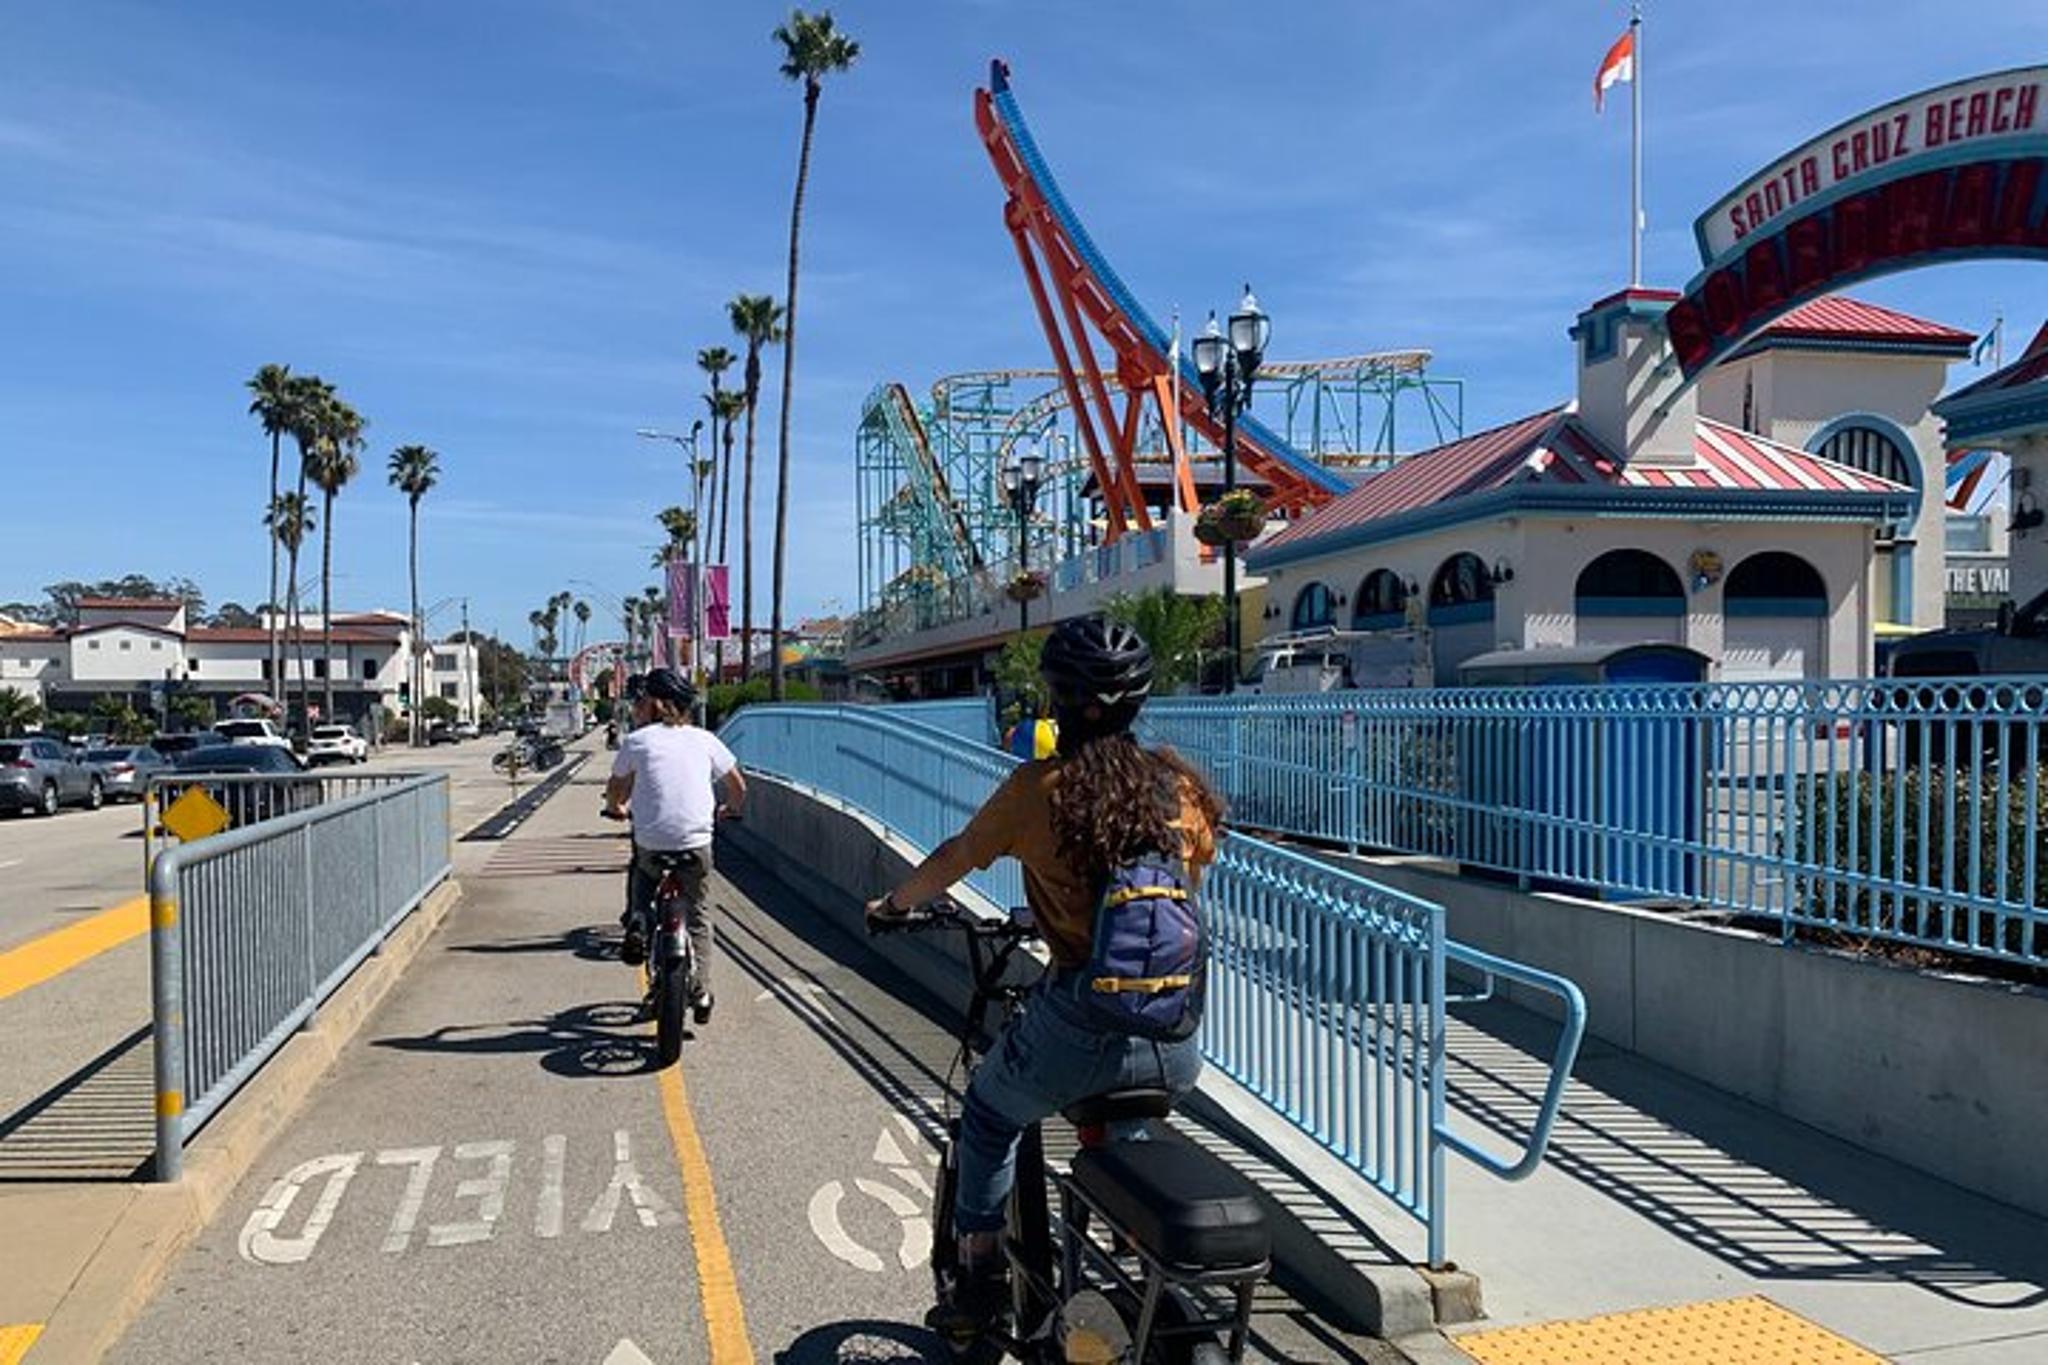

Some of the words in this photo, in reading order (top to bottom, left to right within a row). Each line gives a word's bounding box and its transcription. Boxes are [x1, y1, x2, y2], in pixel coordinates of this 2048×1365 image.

[1729, 157, 1819, 239] SANTA
[1831, 114, 1910, 181] CRUZ
[1925, 84, 2039, 147] BEACH
[1945, 568, 1976, 592] THE
[238, 1131, 677, 1265] YIELD
